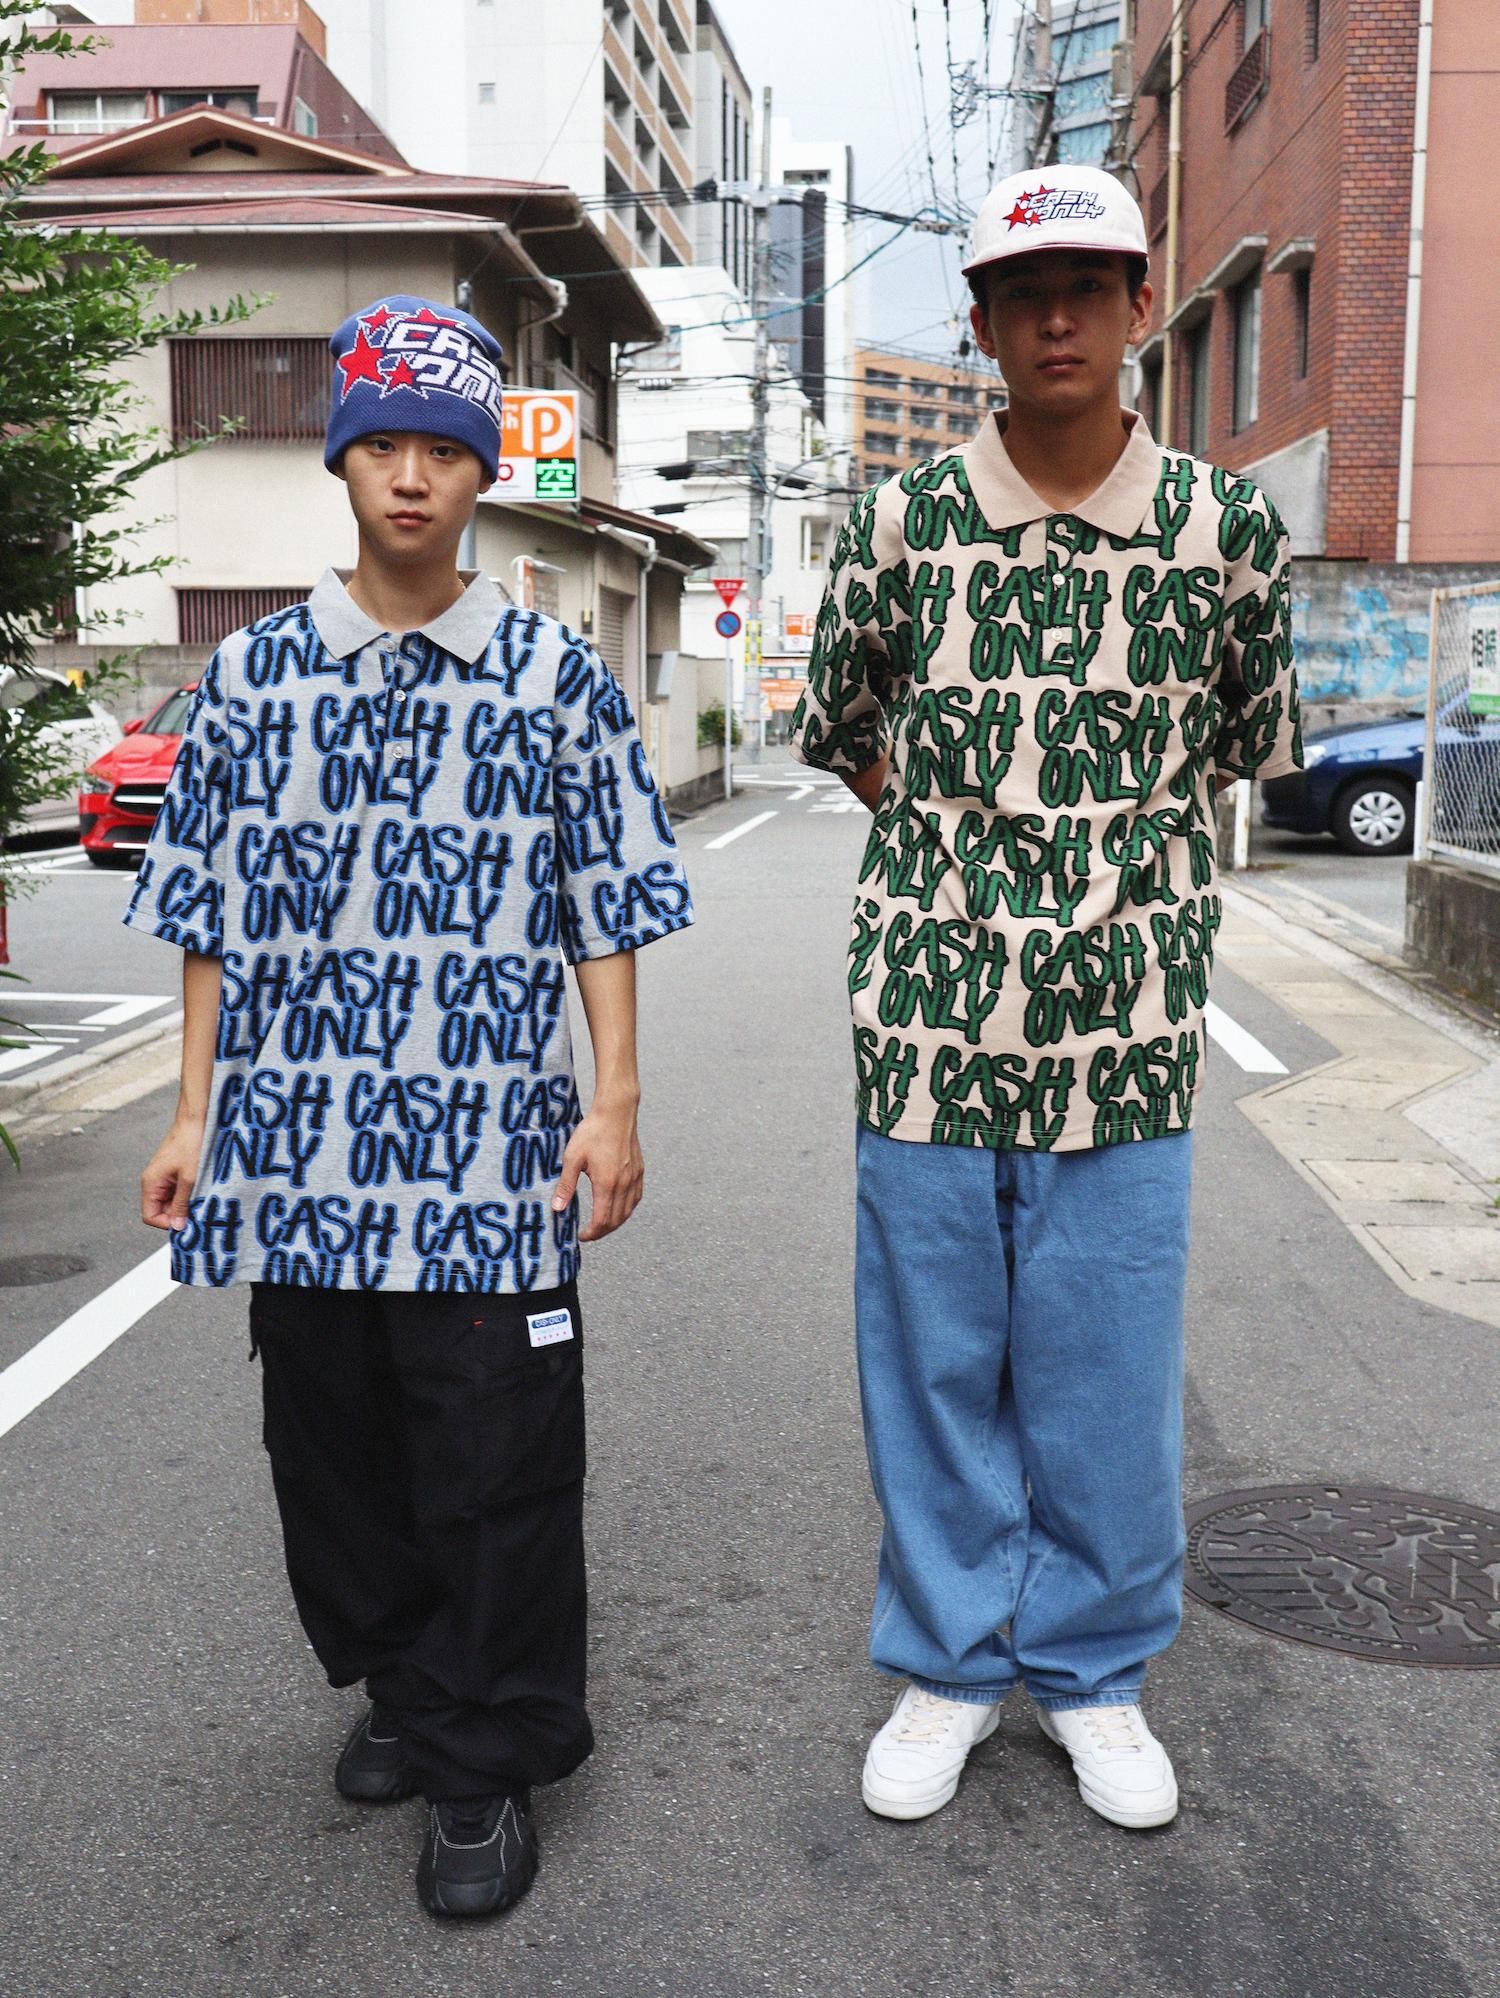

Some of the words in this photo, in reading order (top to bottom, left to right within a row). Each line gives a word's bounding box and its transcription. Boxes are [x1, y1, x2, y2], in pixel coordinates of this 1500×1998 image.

[1027, 189, 1099, 209] CASH
[1037, 203, 1106, 221] ONLY
[521, 398, 572, 453] P
[536, 458, 575, 497] 空
[1035, 689, 1174, 753] CASH
[1036, 747, 1163, 809] ONLY
[236, 821, 361, 888] CASH
[371, 818, 513, 892] CASH
[954, 810, 1092, 876] CASH
[373, 880, 503, 943] ONLY
[962, 863, 1088, 928] ONLY
[884, 911, 1011, 990] CASH
[1019, 922, 1148, 991] CASH
[1150, 894, 1222, 970] CASH
[433, 950, 565, 1018] CASH
[878, 968, 1000, 1045] ONLY
[1023, 981, 1142, 1048] ONLY
[281, 1003, 412, 1071] ONLY
[436, 1010, 556, 1074] ONLY
[929, 1045, 1076, 1113] CASH
[1087, 1030, 1199, 1105] CASH
[345, 1069, 490, 1140] CASH
[1092, 1094, 1195, 1149] ONLY
[347, 1129, 481, 1196] ONLY
[255, 1192, 400, 1260] CASH
[412, 1196, 546, 1263] CASH
